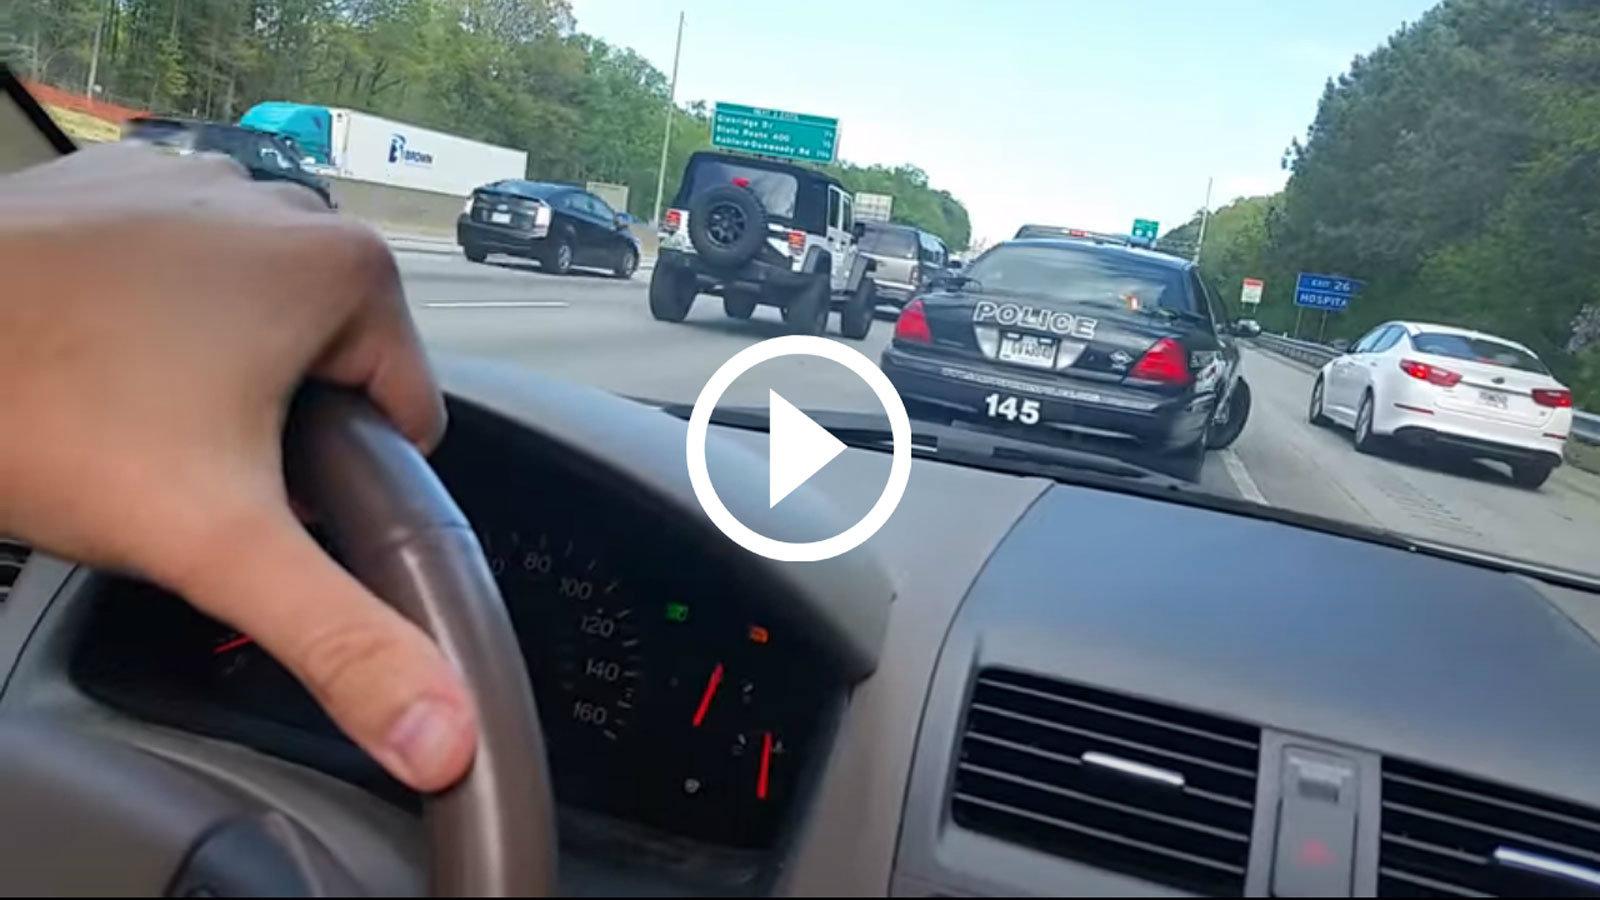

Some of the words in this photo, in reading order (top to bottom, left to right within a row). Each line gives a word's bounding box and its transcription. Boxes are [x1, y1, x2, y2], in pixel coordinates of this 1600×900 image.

[773, 133, 790, 142] 400
[405, 150, 432, 164] BROWN
[1334, 280, 1350, 291] 26
[1300, 293, 1347, 307] HOSPITA
[973, 301, 1097, 338] POLICE
[985, 394, 1040, 425] 145
[524, 552, 550, 572] 80
[560, 577, 593, 599] 100
[581, 615, 615, 637] 120
[586, 658, 620, 681] 140
[573, 702, 607, 724] 160
